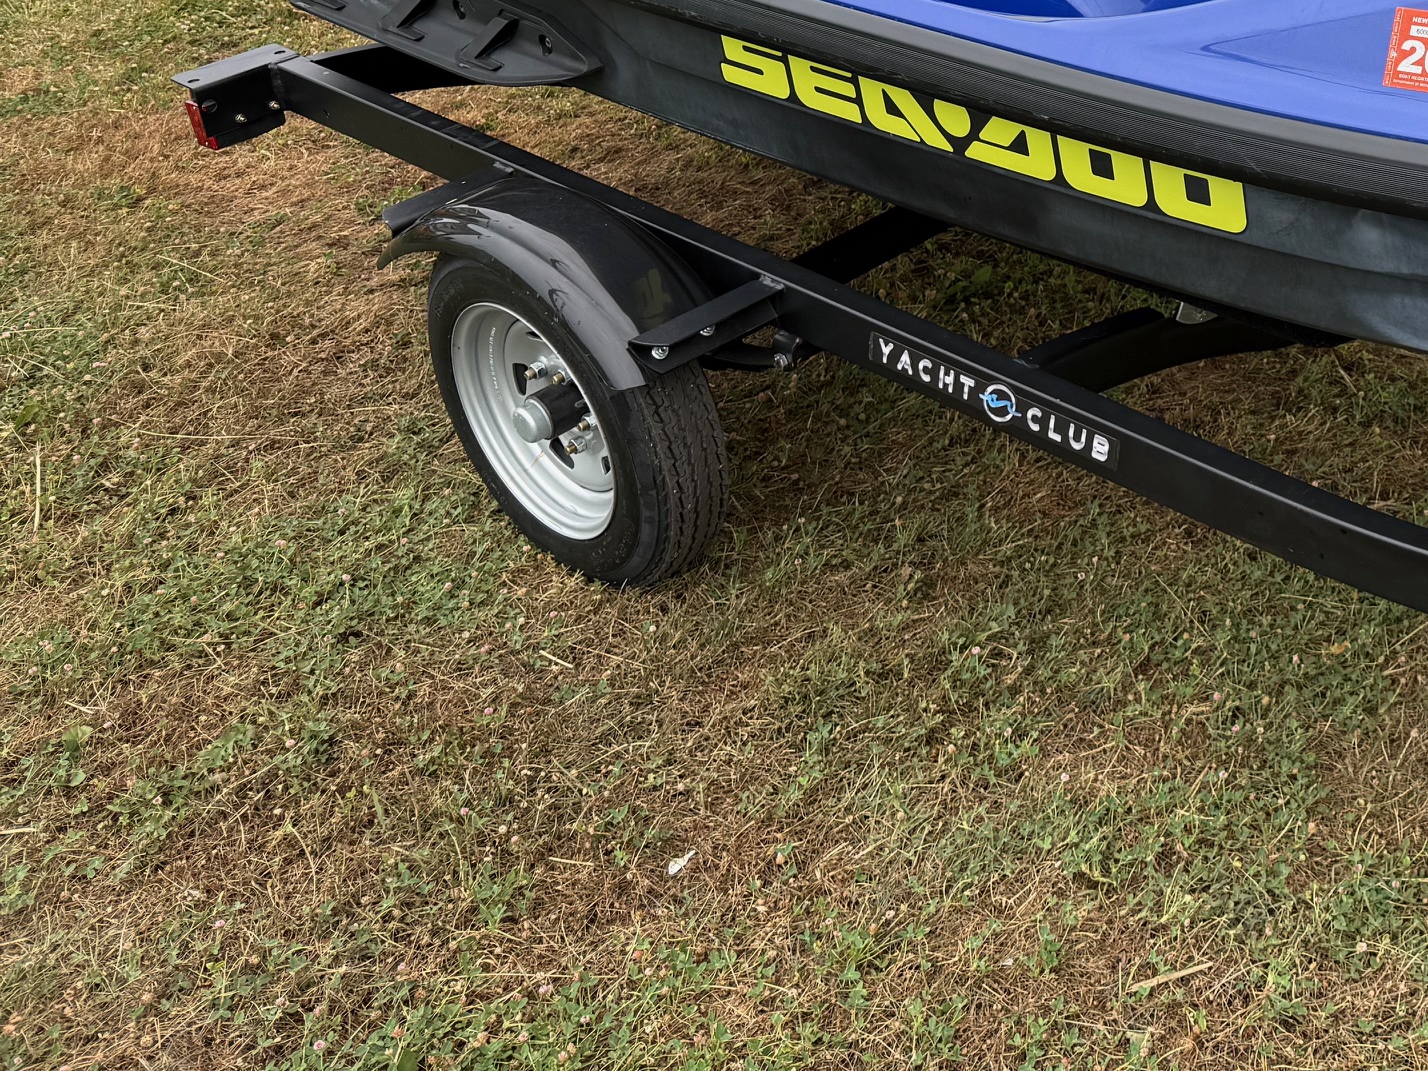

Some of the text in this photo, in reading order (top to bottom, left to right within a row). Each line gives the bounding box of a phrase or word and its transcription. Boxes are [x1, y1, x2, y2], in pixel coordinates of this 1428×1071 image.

[1412, 16, 1428, 24] NEW
[878, 337, 1111, 463] YACHT CLUB
